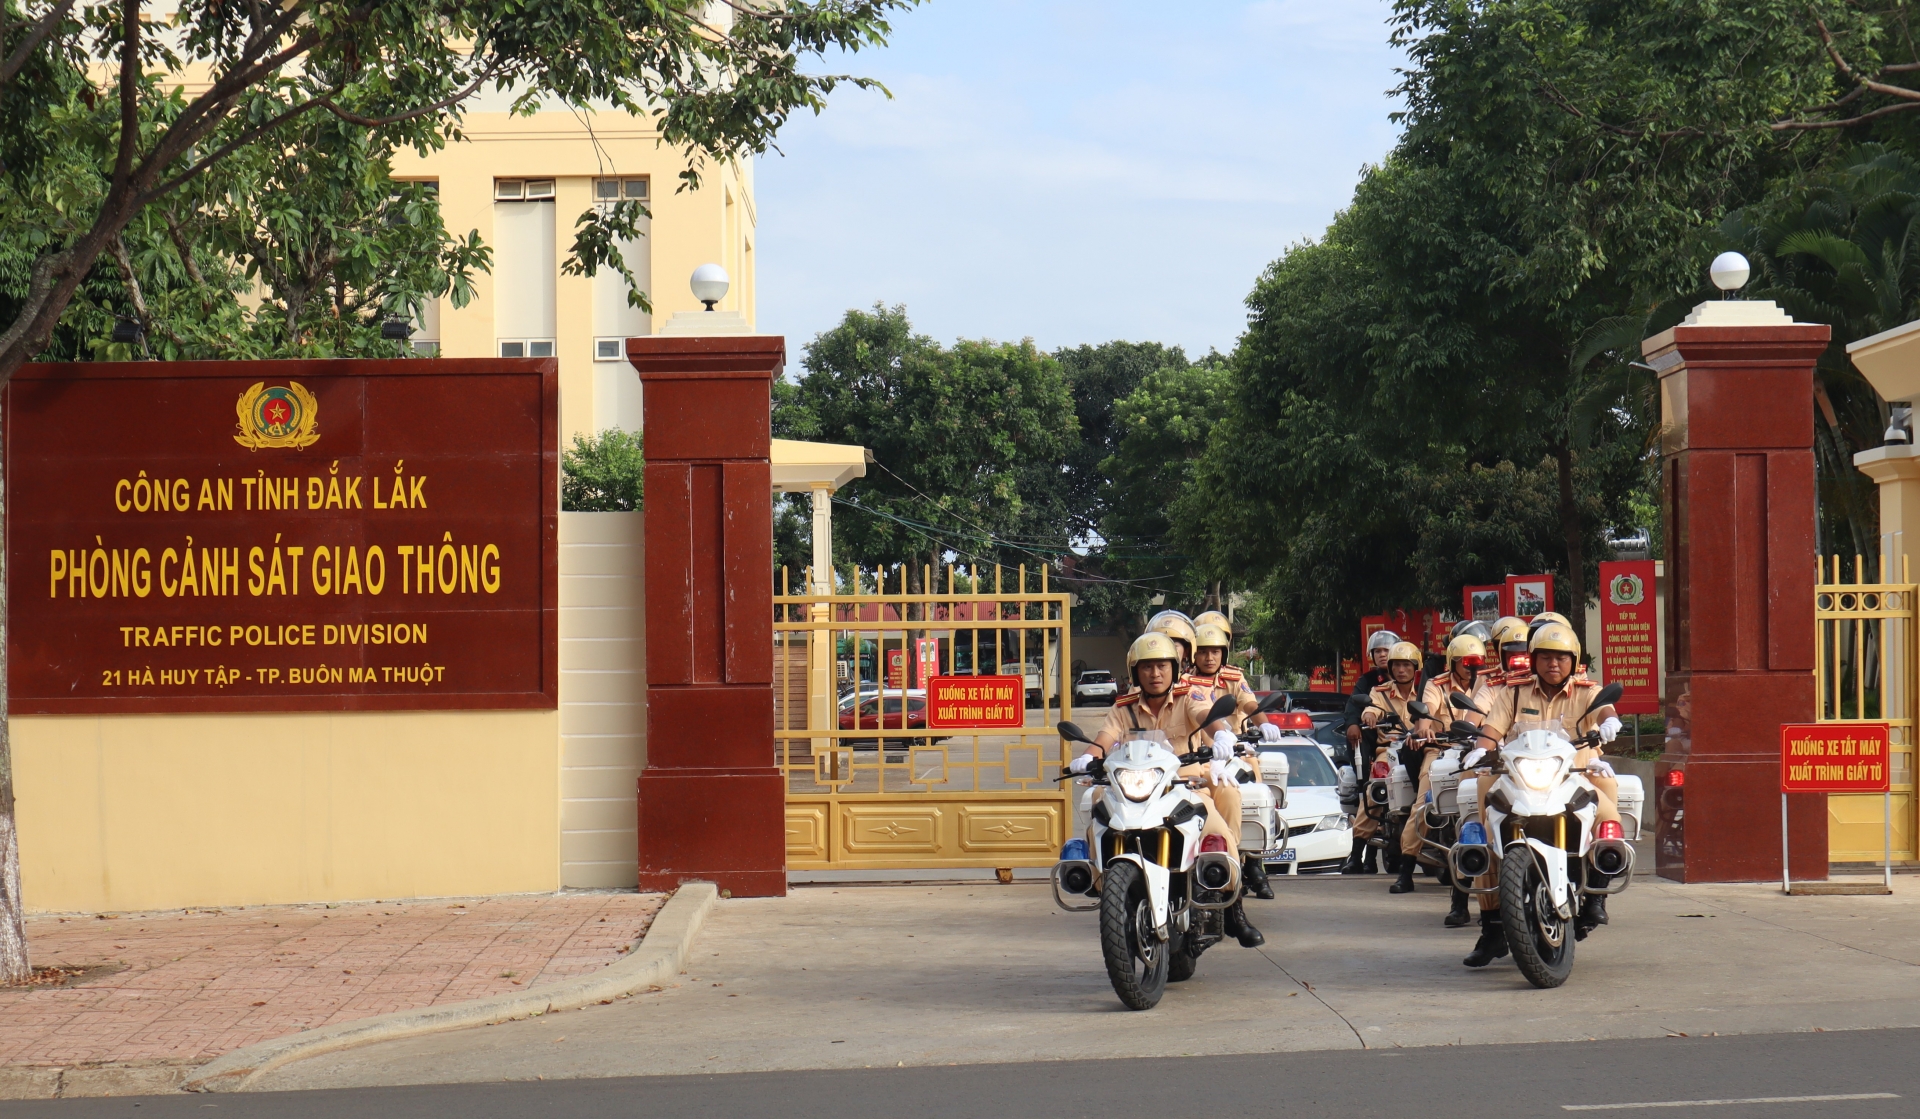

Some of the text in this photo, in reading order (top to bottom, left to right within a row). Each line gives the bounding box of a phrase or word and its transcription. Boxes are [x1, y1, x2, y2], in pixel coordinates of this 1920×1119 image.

[116, 460, 427, 512] CÔNG AN TỈNH ĐẮK LẮK
[51, 532, 500, 598] PHÒNG CẢNH SÁT GIAO THÔNG
[120, 624, 426, 646] TRAFFIC POLICE DIVISION
[103, 671, 120, 685] 21
[129, 666, 154, 685] HÀ
[161, 670, 198, 684] HUY
[204, 665, 240, 688] TẬP
[257, 669, 284, 683] TP.
[290, 664, 342, 683] BUÔN
[349, 668, 377, 682] MA
[382, 663, 445, 685] THUỘT
[939, 683, 1013, 700] XUỐNG XE TẮT MÁY
[938, 702, 1014, 719] XUẤT TRÌNH GIẤY TỜ
[1790, 734, 1880, 755] XUỐNG XE TẮT MÁY
[1789, 759, 1882, 780] XUẤT TRÌNH GIẤY TỜ
